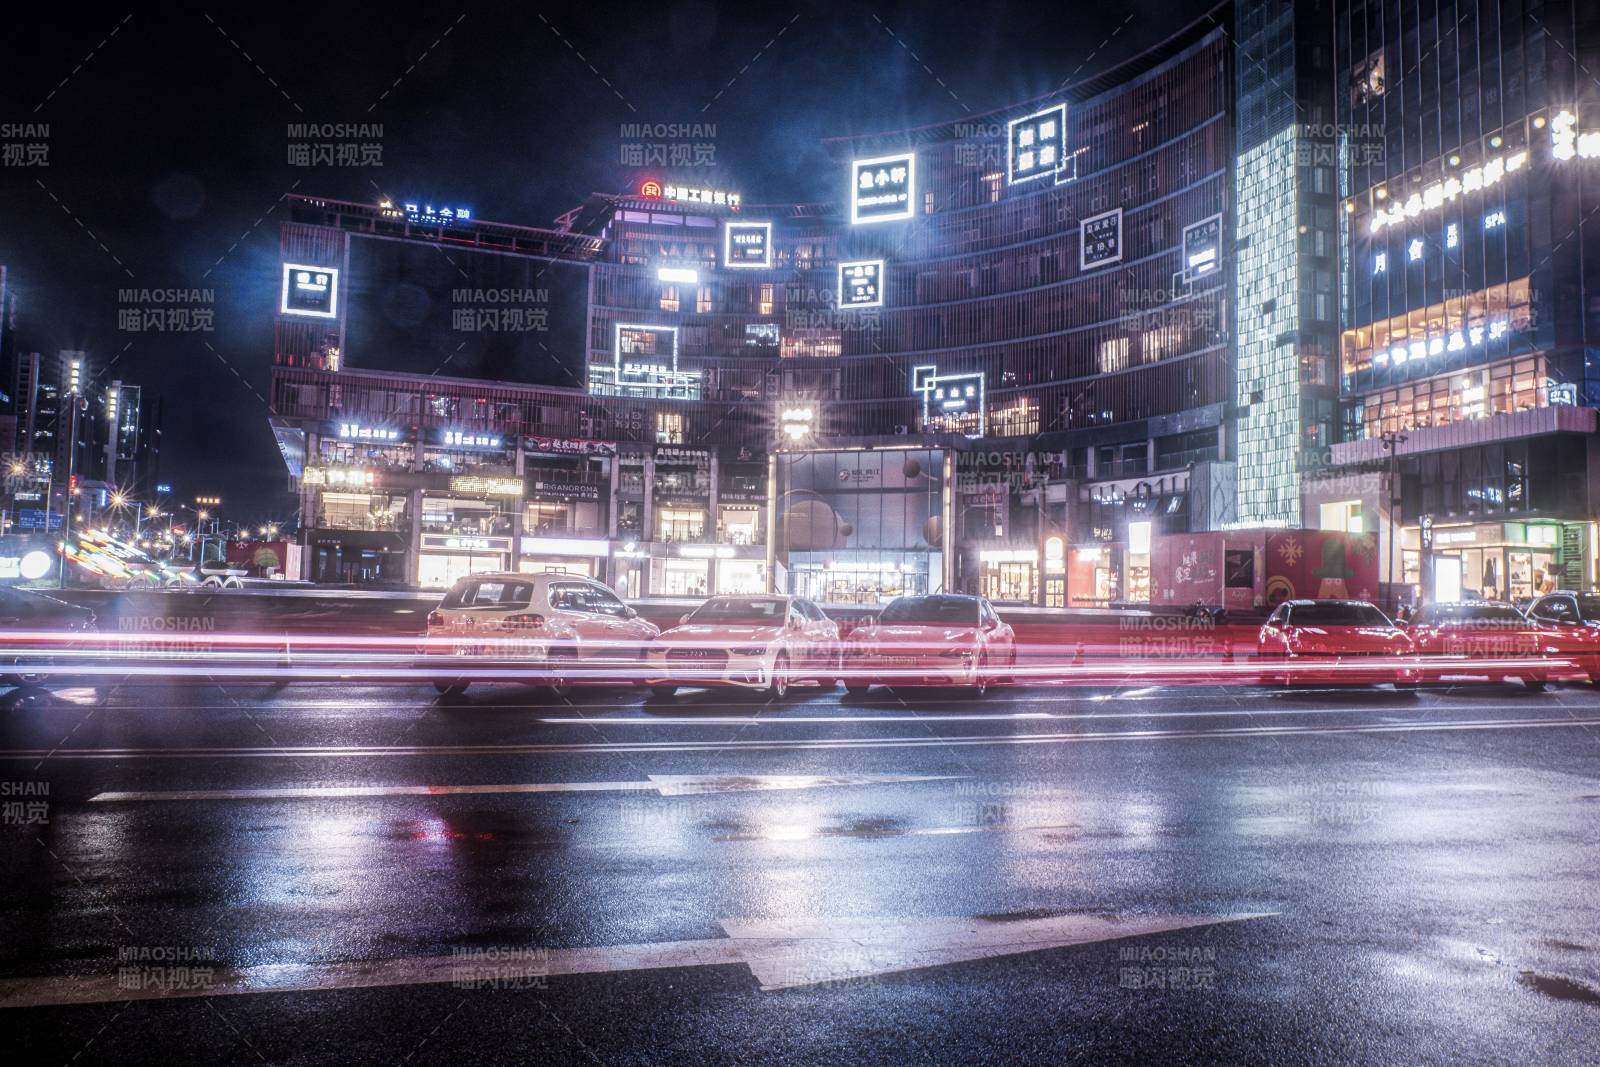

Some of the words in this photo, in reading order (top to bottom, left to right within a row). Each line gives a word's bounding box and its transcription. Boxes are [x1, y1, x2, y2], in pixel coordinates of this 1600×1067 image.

[664, 186, 740, 207] 中国工商银行
